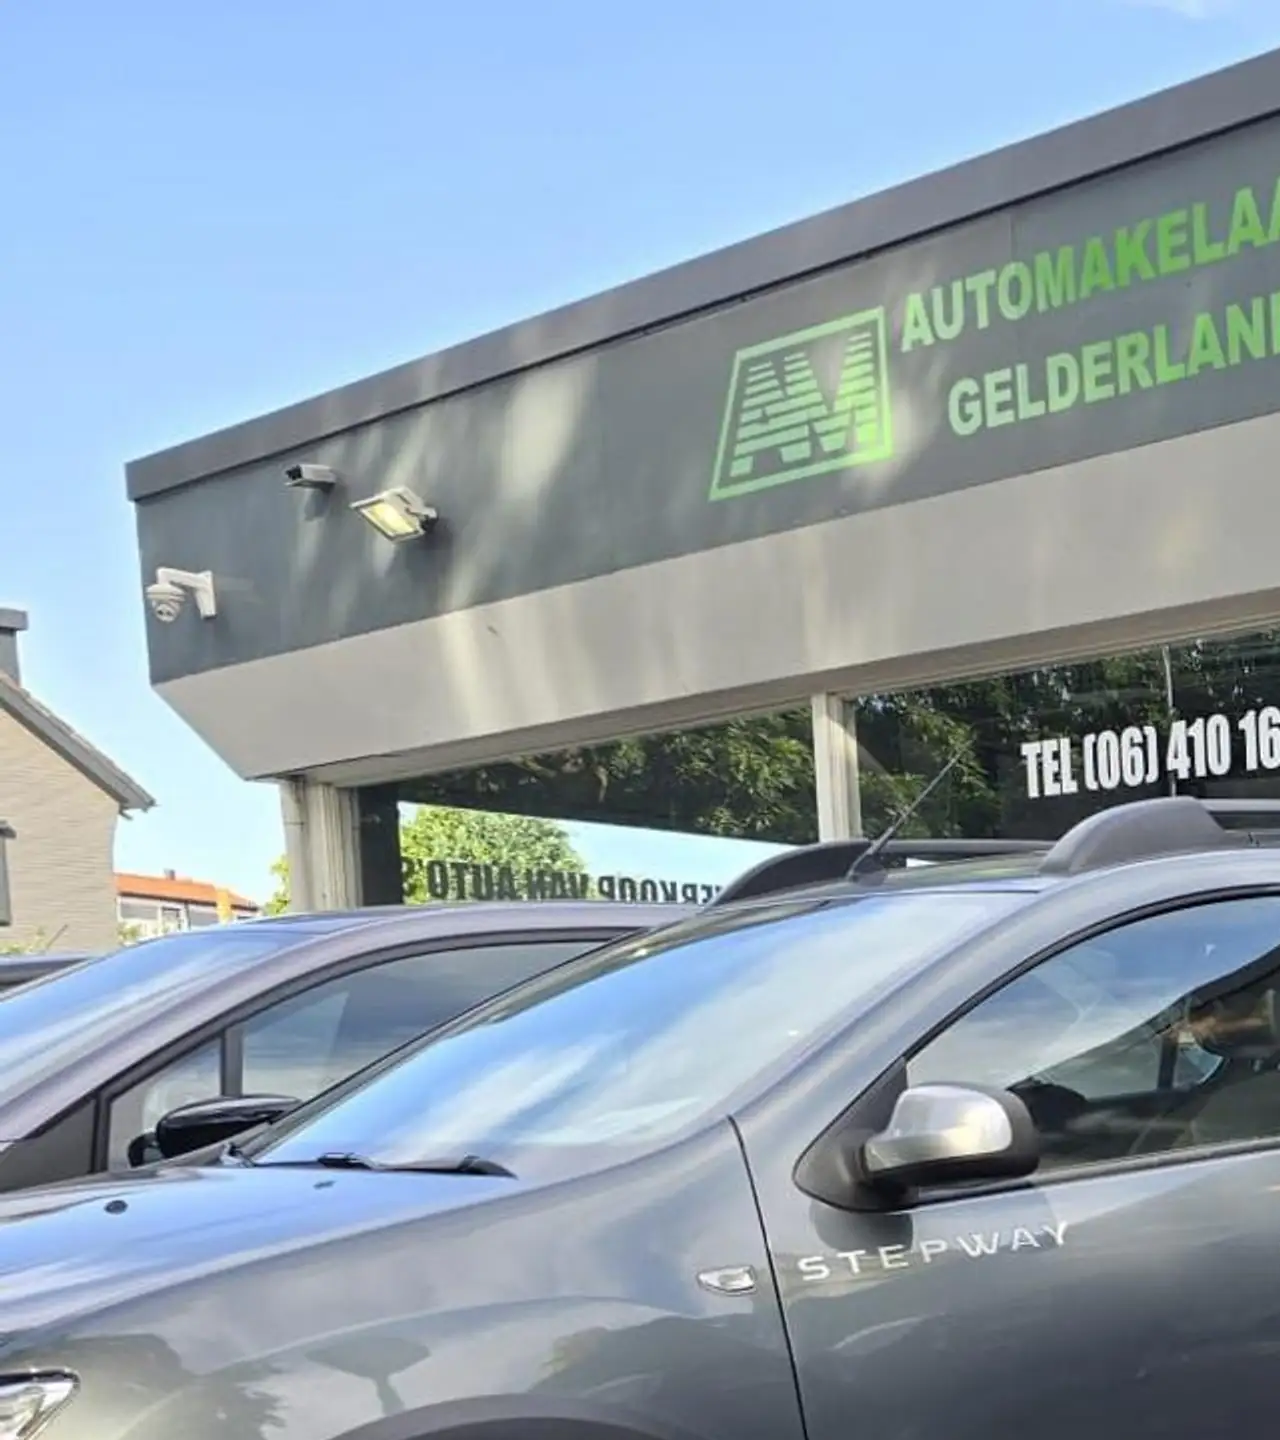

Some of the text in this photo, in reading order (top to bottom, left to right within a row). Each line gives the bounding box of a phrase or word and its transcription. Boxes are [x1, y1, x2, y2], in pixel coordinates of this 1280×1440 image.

[1020, 737, 1079, 800] TEL
[1084, 725, 1160, 791] (06)
[1166, 713, 1232, 780] 410
[797, 1219, 1070, 1283] STEPWAY
